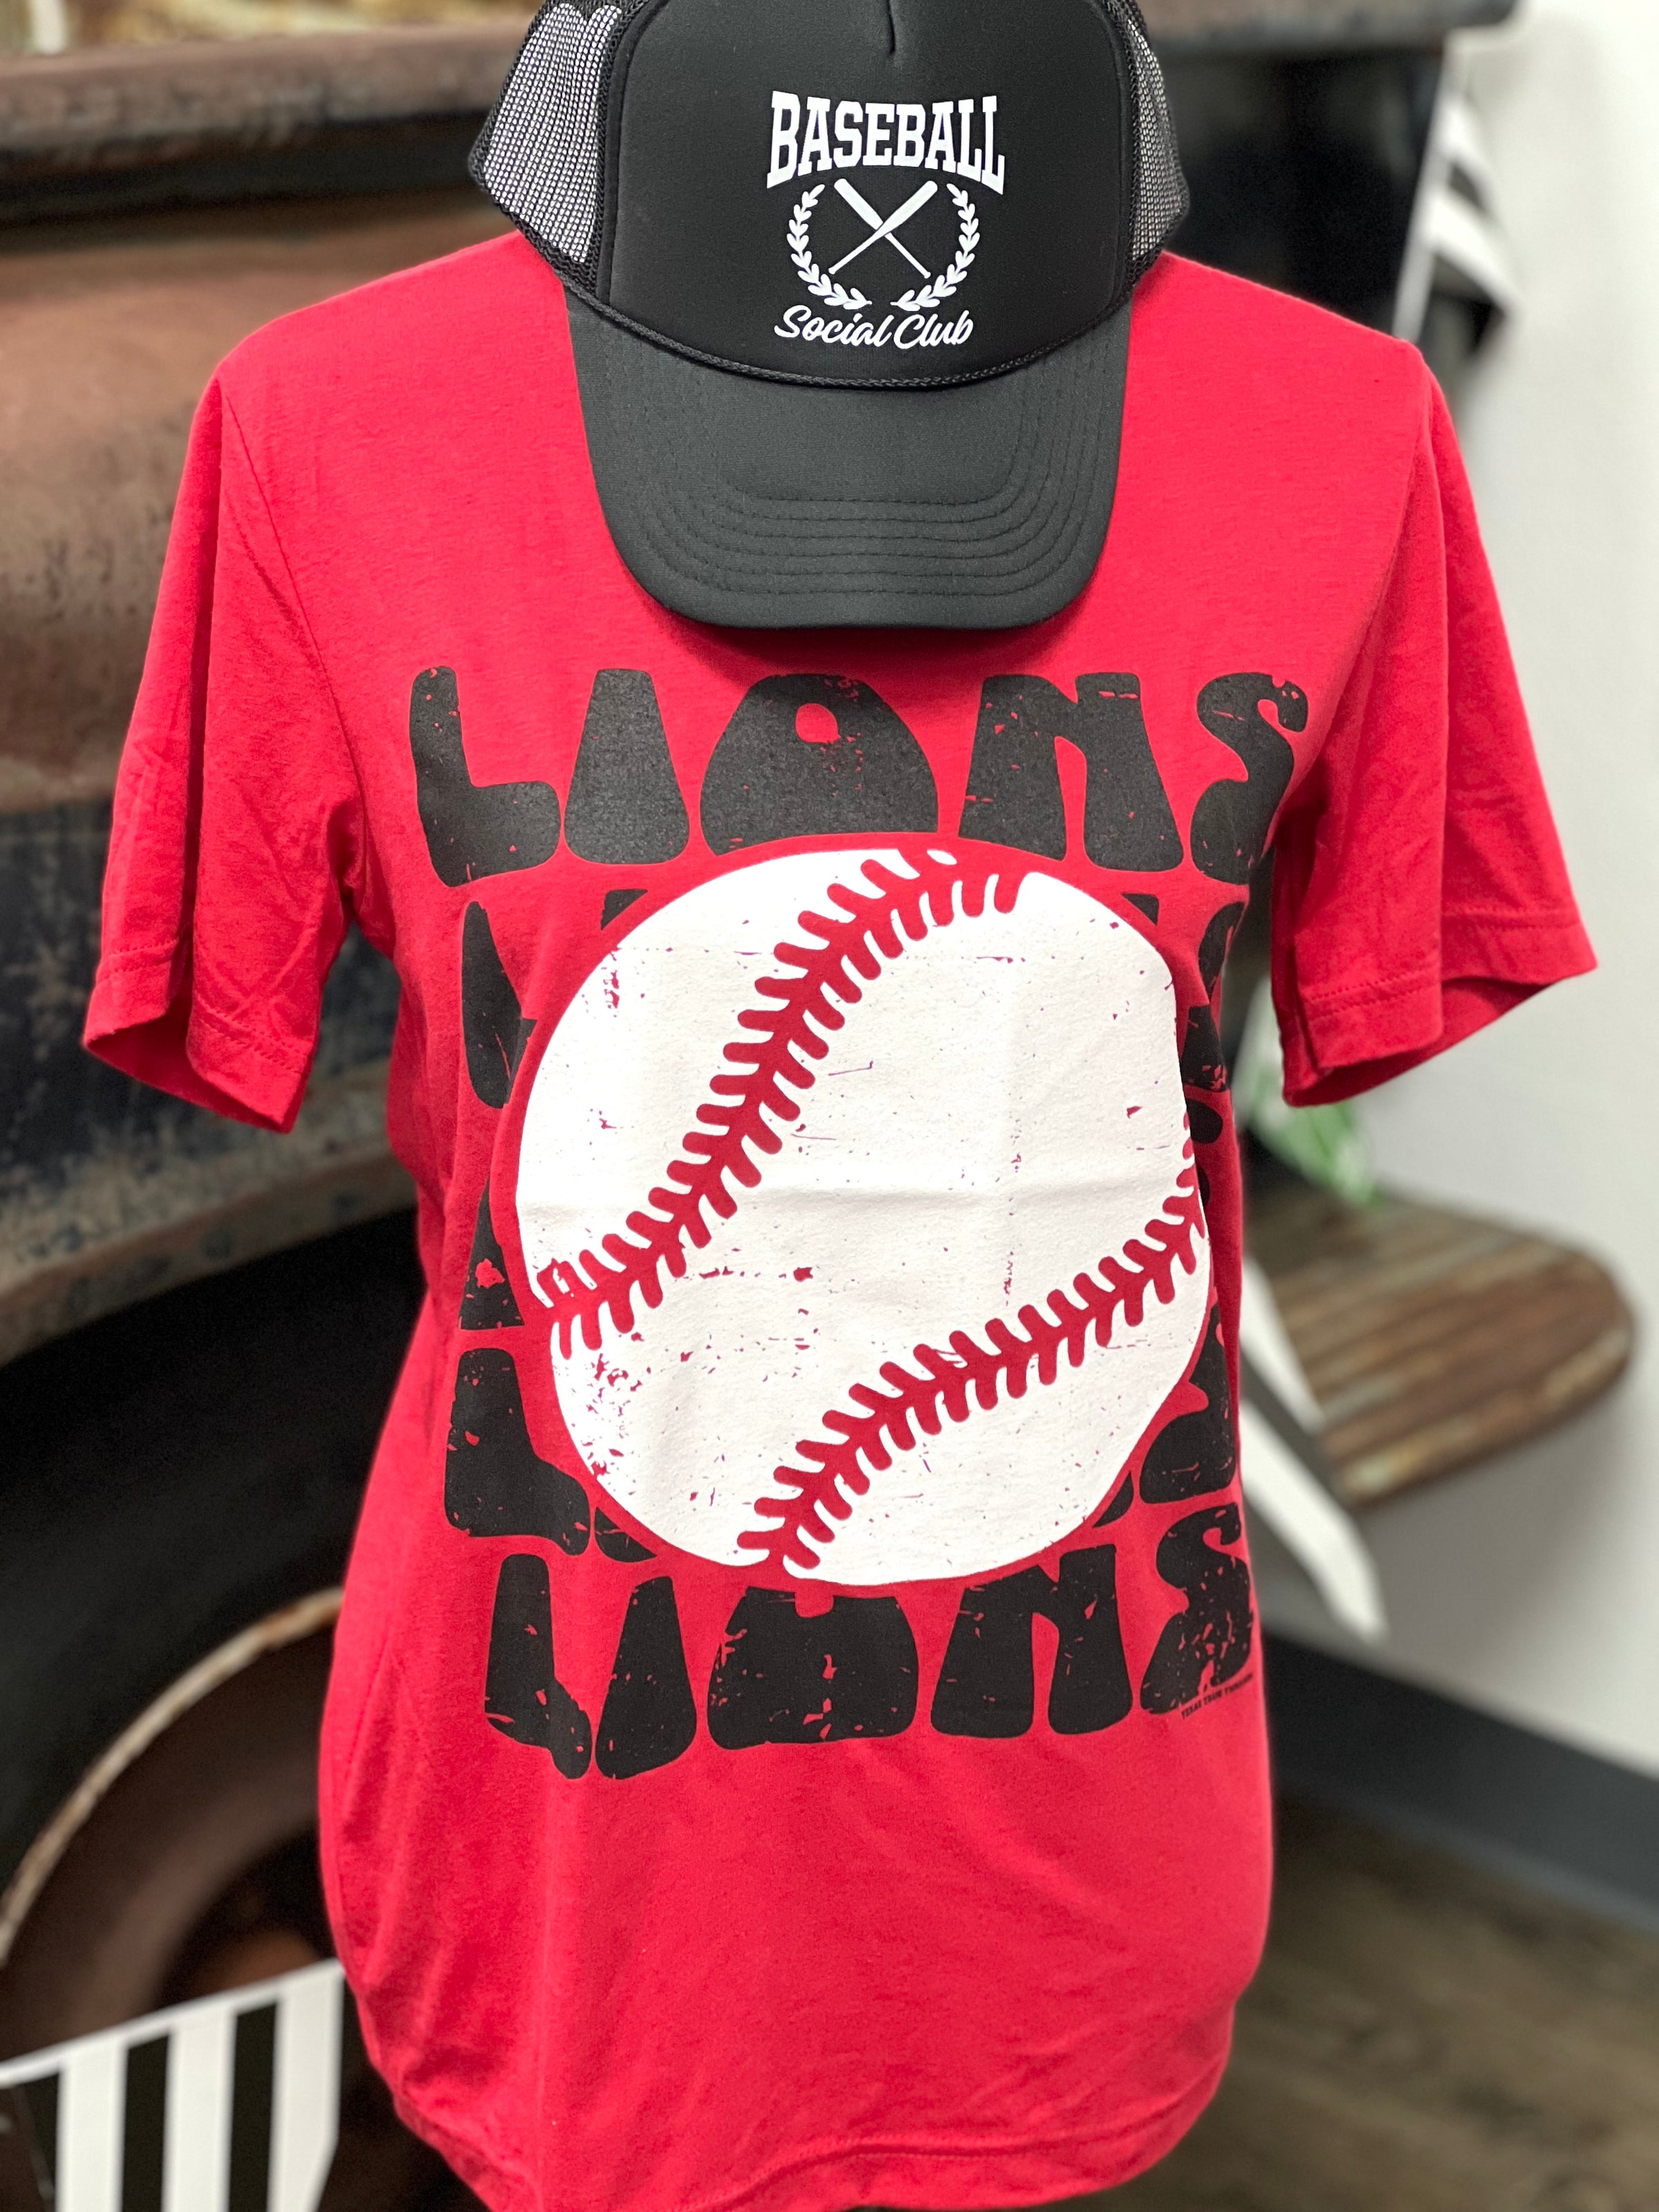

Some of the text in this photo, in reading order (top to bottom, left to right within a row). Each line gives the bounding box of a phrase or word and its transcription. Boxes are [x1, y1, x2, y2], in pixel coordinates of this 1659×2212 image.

[767, 91, 1005, 195] BASEBALL
[774, 305, 974, 349] Social Club
[409, 666, 1309, 888] LIONS
[484, 1502, 1252, 1779] LIONS
